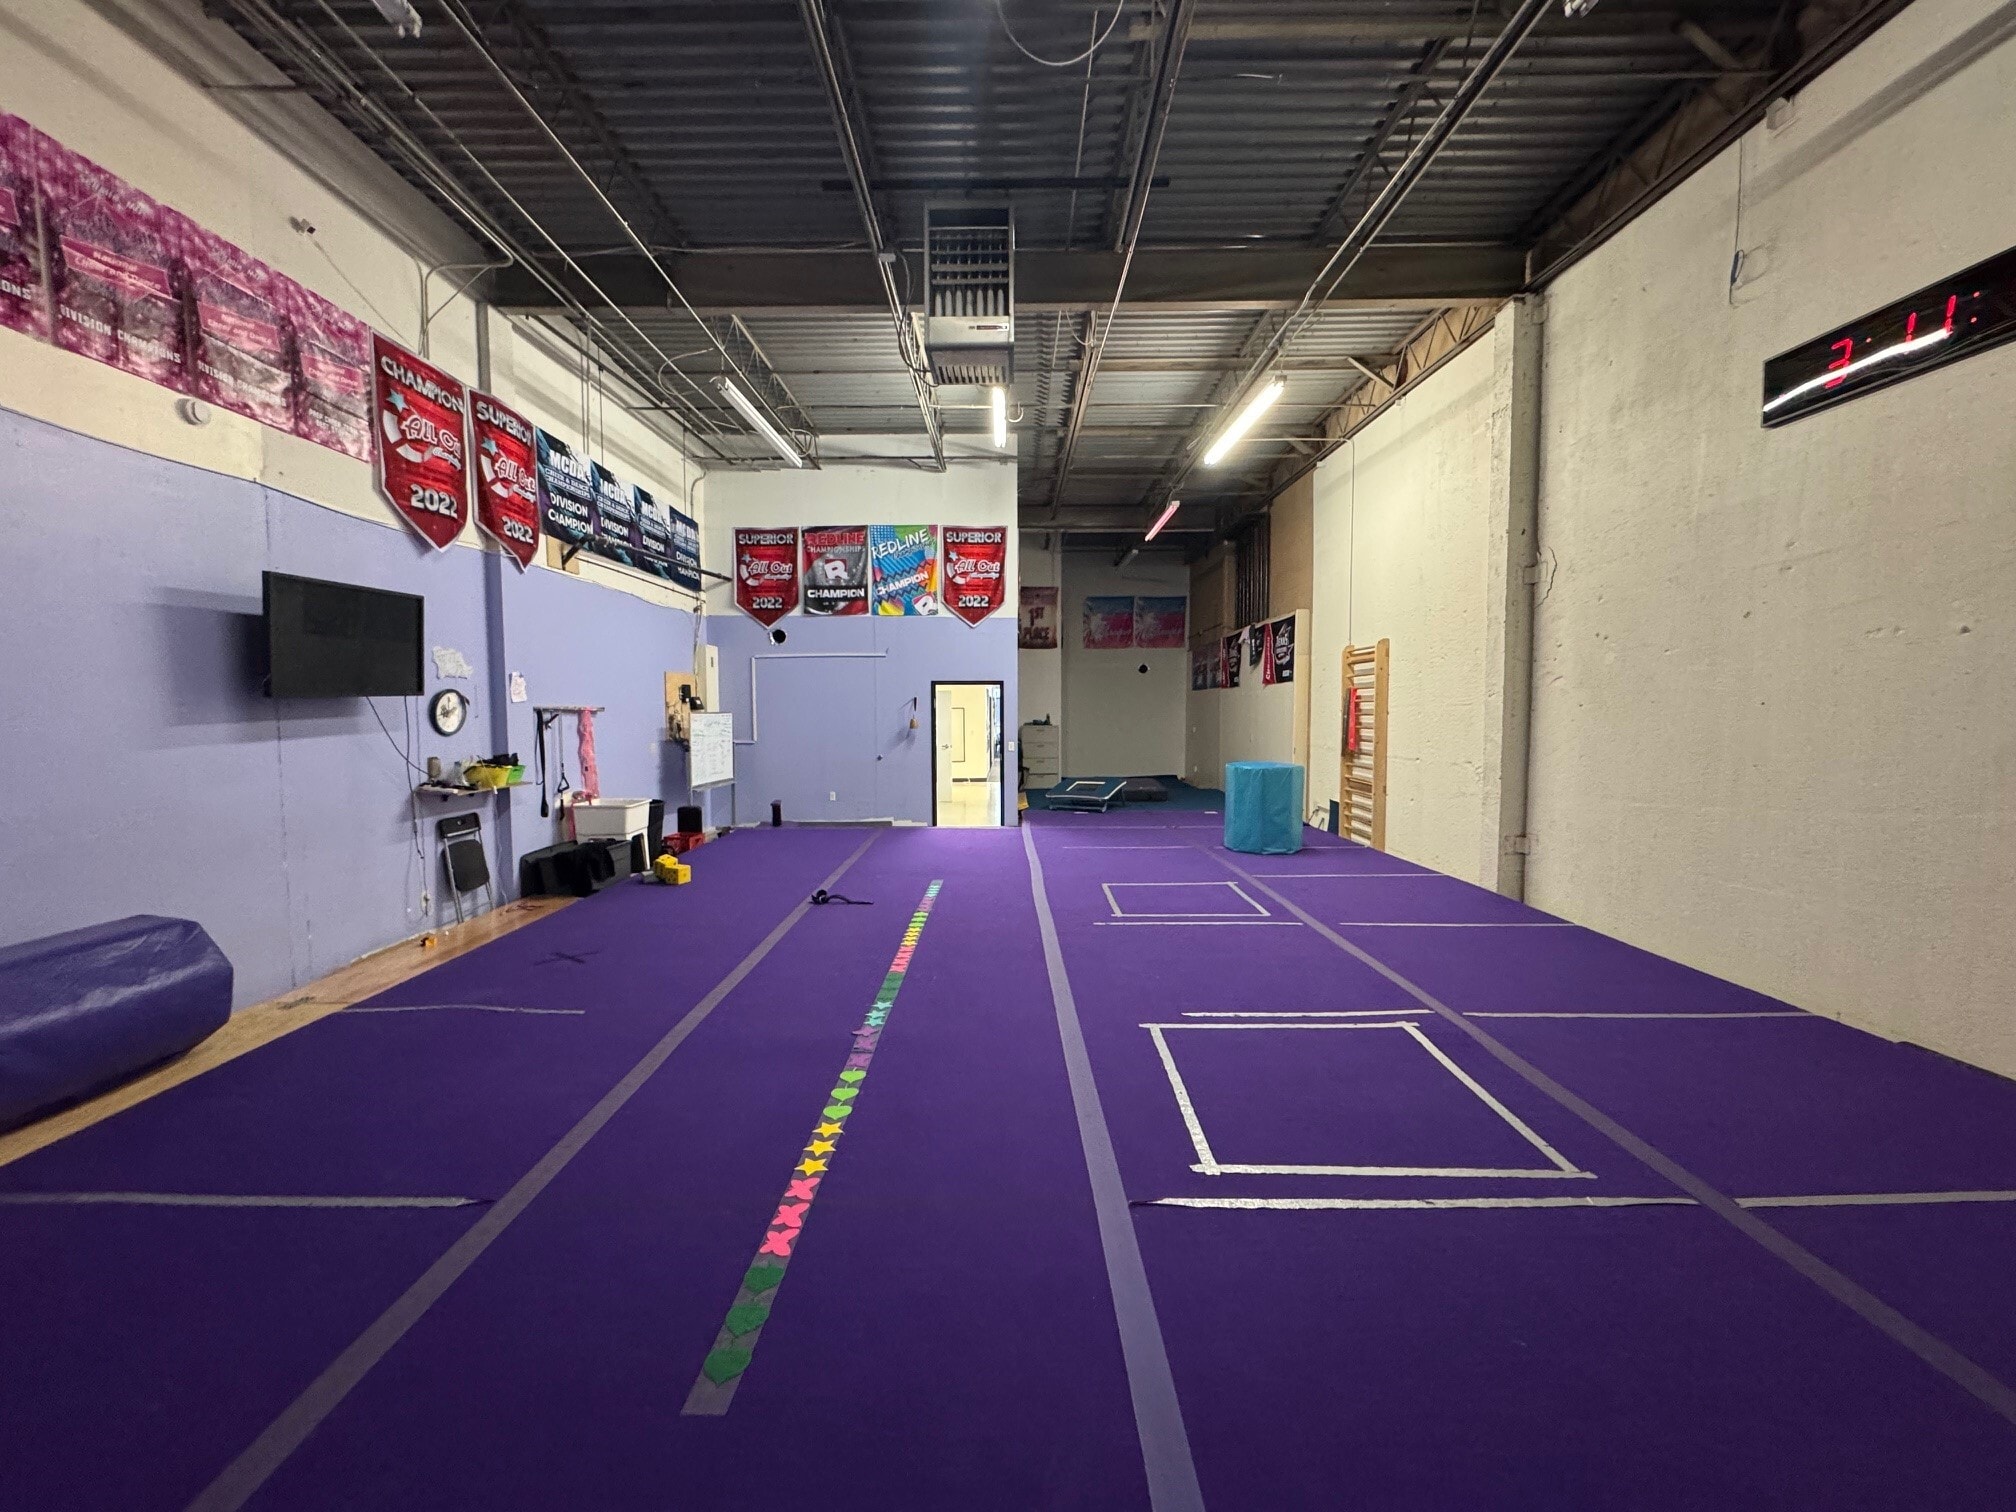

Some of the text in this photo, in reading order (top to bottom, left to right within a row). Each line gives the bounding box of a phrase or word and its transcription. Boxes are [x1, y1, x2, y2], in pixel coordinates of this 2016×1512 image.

[380, 355, 465, 415] CHAMPION
[401, 414, 437, 445] All
[476, 401, 532, 446] SUPERIOR
[495, 458, 518, 481] All
[549, 449, 586, 482] MCDA
[410, 484, 458, 519] 2022
[600, 478, 626, 506] MCDA
[549, 492, 588, 518] DIVISION
[502, 515, 534, 544] 2022
[548, 508, 594, 535] CHAMPION
[601, 517, 629, 538] DIVISION
[642, 535, 665, 553] DIVISION
[738, 533, 794, 545] SUPERIOR
[804, 532, 865, 545] REDLINE
[872, 529, 929, 559] REDLINE
[946, 531, 1002, 543] SUPERIOR
[748, 561, 793, 575] All Out
[824, 560, 850, 580] R
[955, 559, 1000, 573] All Out
[807, 588, 865, 598] CHAMPION
[876, 570, 929, 595] CHAMPION
[752, 597, 783, 609] 2022
[958, 595, 989, 608] 2022
